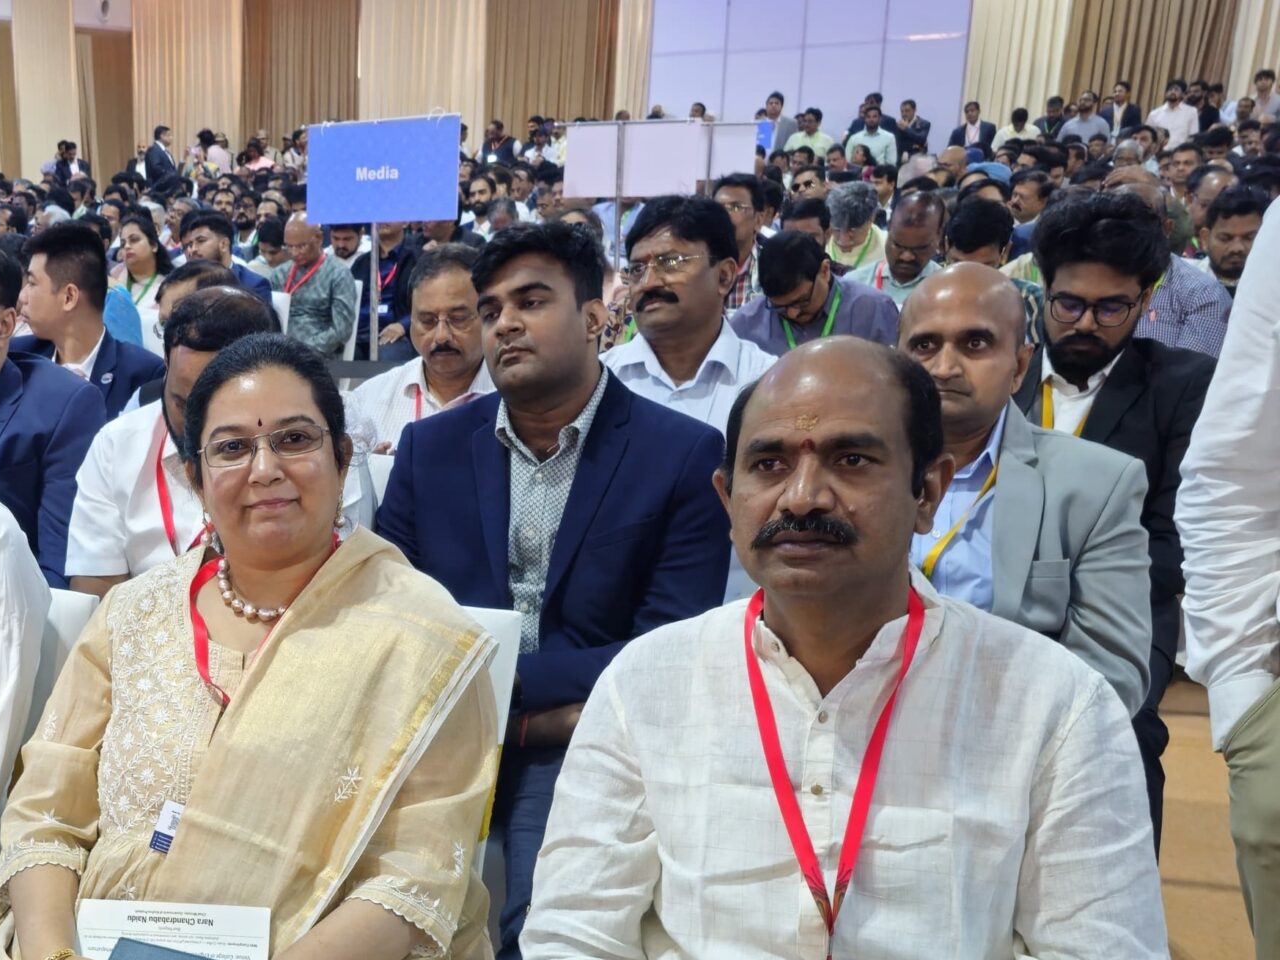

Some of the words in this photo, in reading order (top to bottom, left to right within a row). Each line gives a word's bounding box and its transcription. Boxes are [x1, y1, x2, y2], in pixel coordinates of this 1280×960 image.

[356, 166, 398, 181] Media
[127, 915, 147, 924] Naidu
[149, 916, 195, 926] Chandrababu
[197, 918, 214, 927] Nara
